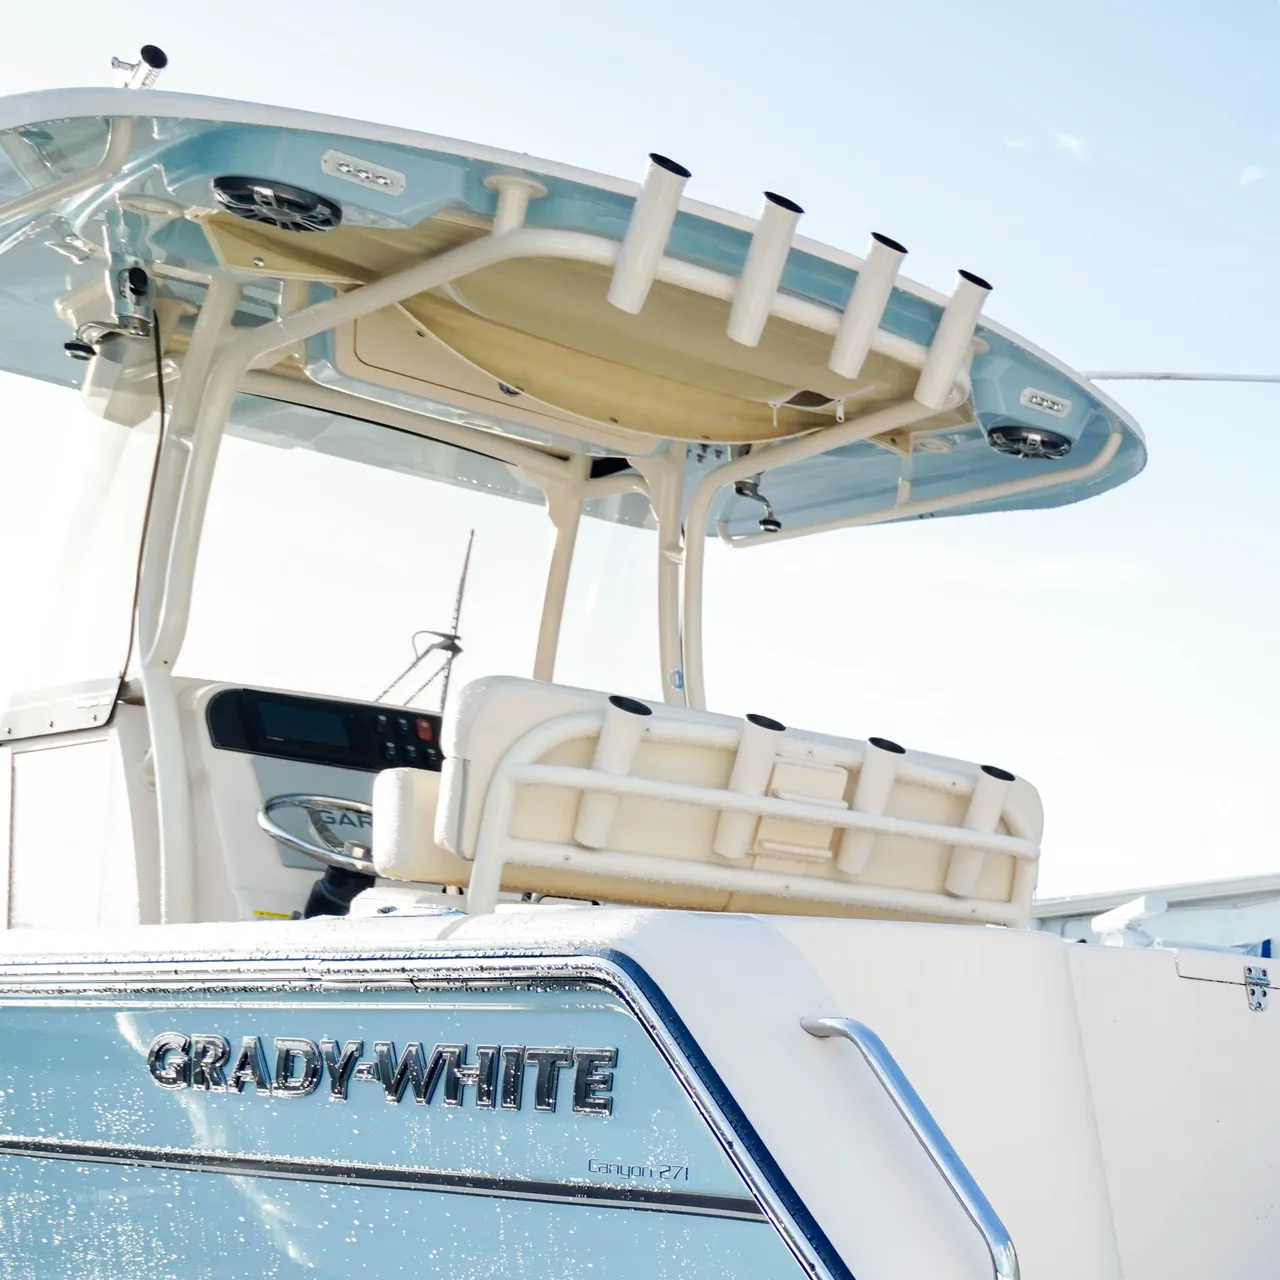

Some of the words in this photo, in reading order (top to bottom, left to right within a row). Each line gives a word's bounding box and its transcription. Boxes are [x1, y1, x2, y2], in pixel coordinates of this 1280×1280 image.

[146, 1031, 619, 1117] GRADY-WHITE
[588, 1158, 653, 1179] Canyon
[660, 1164, 689, 1181] 271
